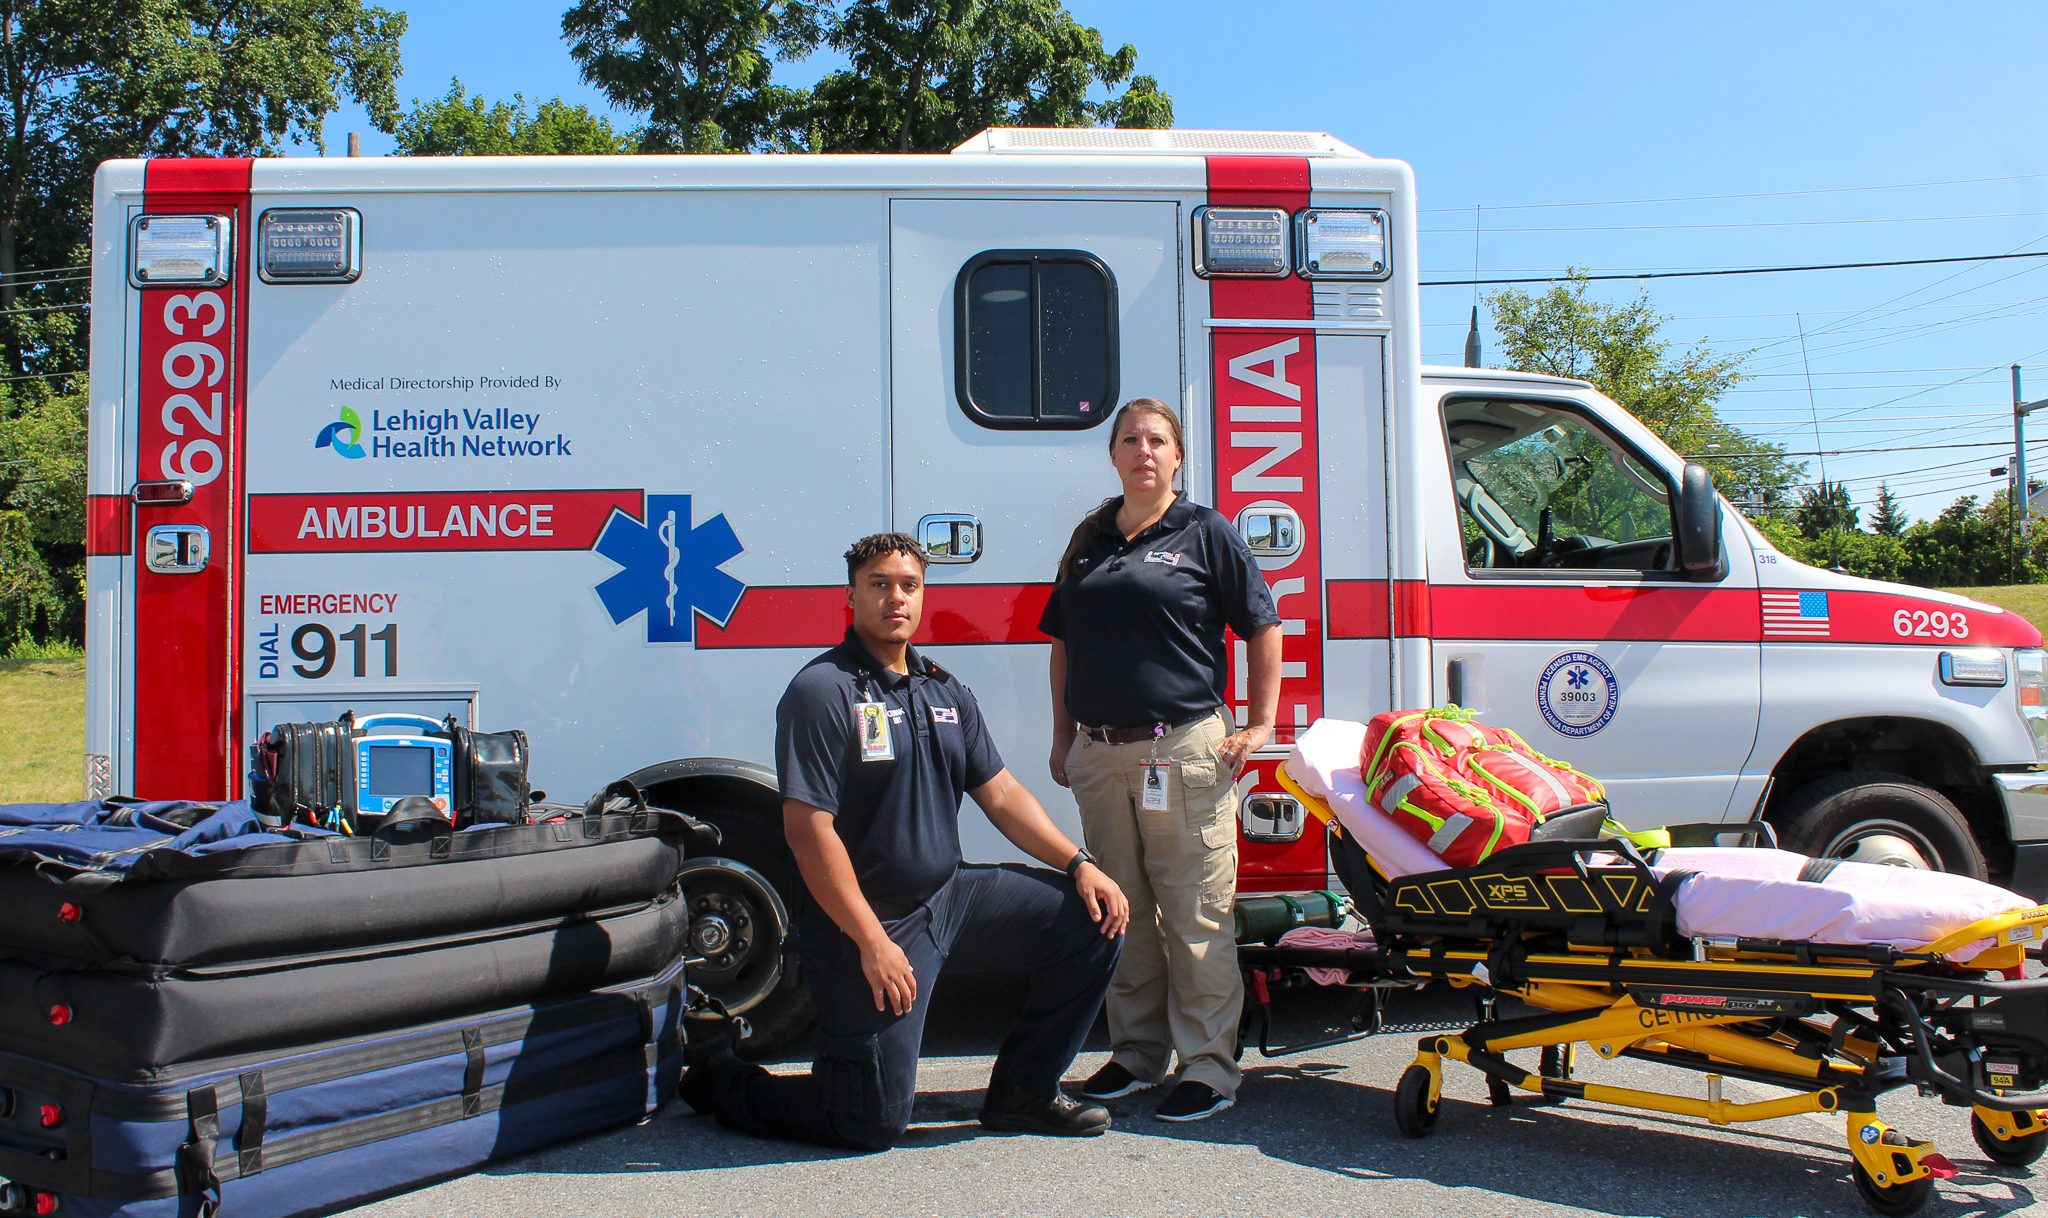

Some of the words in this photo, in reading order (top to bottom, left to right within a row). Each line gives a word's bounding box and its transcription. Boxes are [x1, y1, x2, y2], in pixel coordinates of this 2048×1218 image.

[160, 291, 226, 487] 6293
[330, 377, 384, 390] Medical
[390, 376, 474, 393] Directorship
[480, 376, 539, 389] Provided
[545, 376, 562, 391] By
[373, 408, 459, 434] Lehigh
[462, 408, 541, 435] Valley
[373, 434, 456, 458] Health
[462, 434, 573, 457] Network
[298, 504, 554, 539] AMBULANCE
[1759, 555, 1777, 564] 318
[260, 593, 399, 615] EMERGENCY
[1893, 609, 1969, 639] 6293
[259, 623, 279, 679] DIAL
[291, 623, 398, 679] 911
[1543, 655, 1571, 680] LICENSED
[1572, 653, 1588, 662] EMS
[1587, 655, 1612, 681] AGENCY
[1539, 681, 1561, 730] PENNSYLVANIA
[1561, 718, 1605, 735] DEPARTMENT
[1603, 709, 1612, 720] OF
[1608, 682, 1617, 710] HEALTH
[1560, 691, 1596, 702] 39003
[1488, 885, 1527, 899] XPS
[1660, 993, 1728, 1006] power
[1994, 1076, 2011, 1085] 94A
